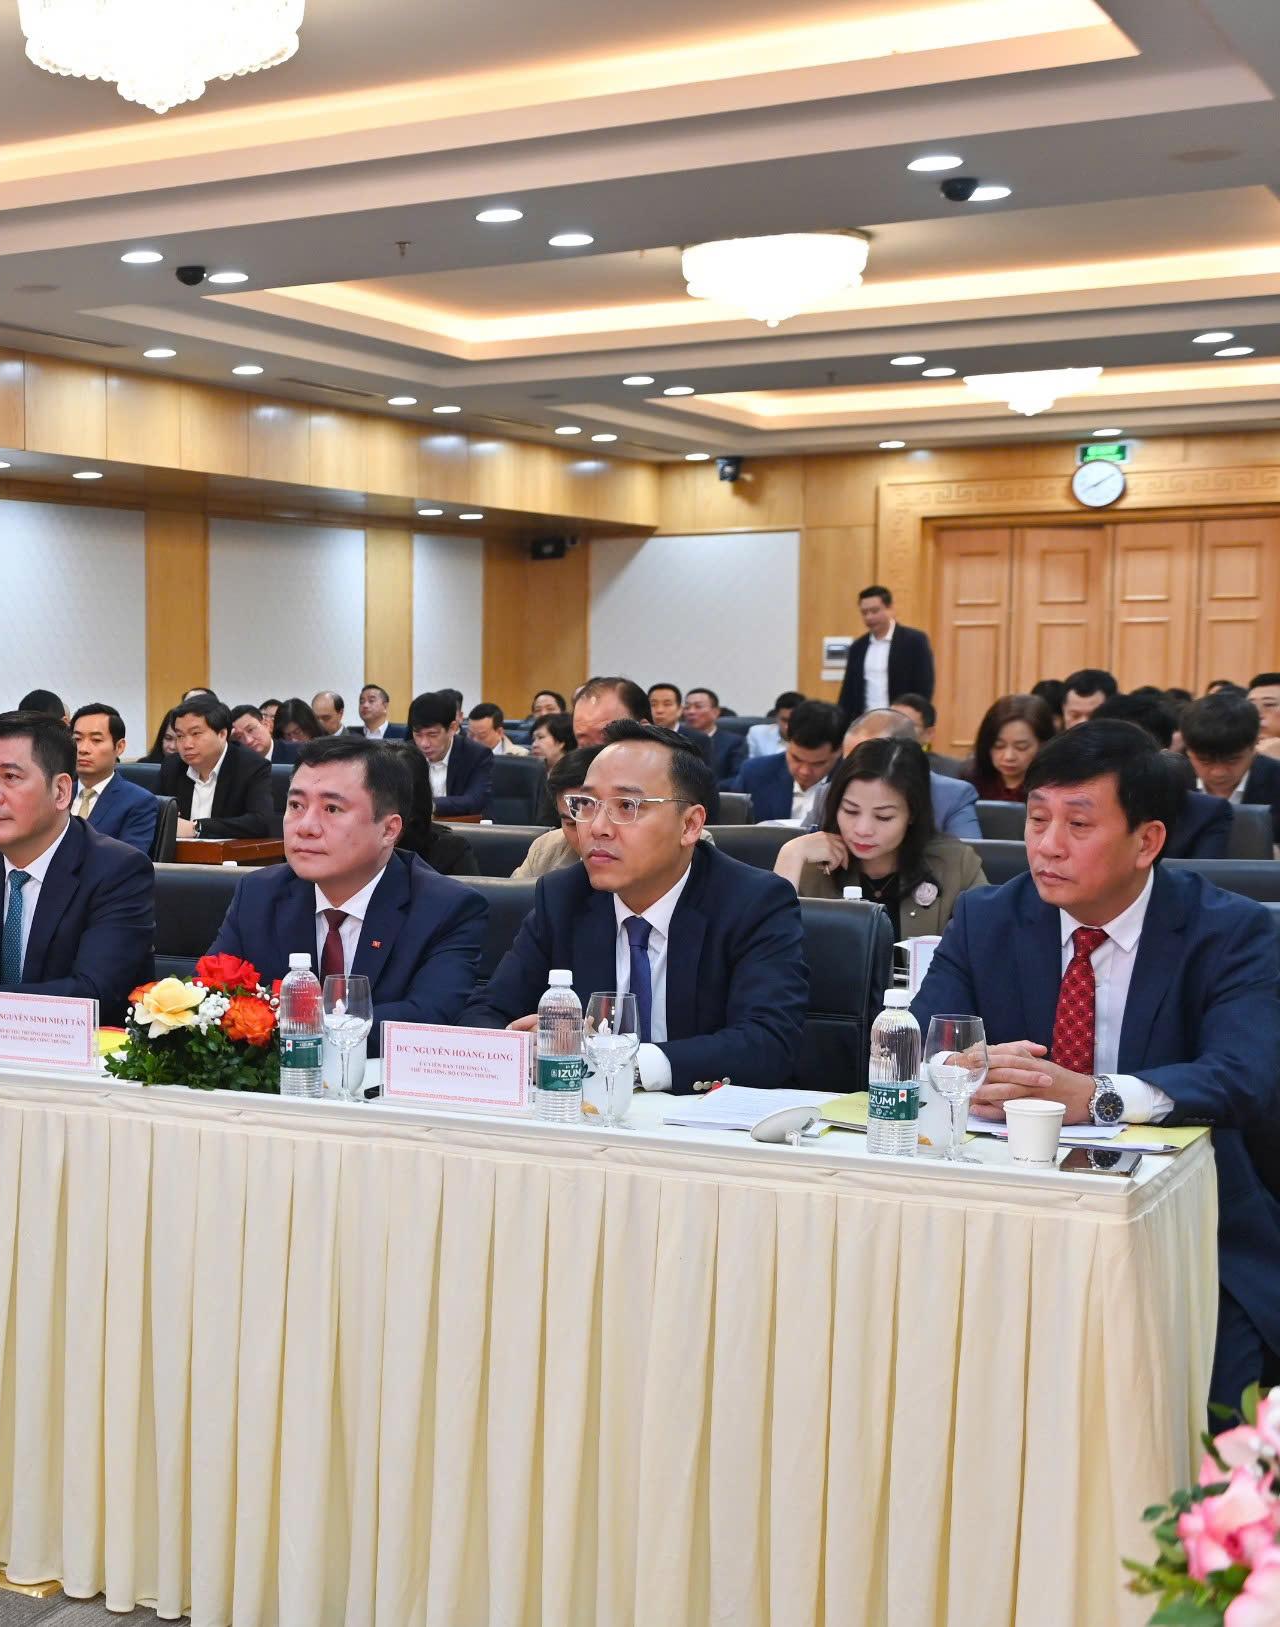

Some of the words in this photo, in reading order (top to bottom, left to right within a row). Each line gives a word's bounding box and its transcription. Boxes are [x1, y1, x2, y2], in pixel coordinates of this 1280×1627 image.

[29, 1014, 48, 1024] SINH
[486, 1051, 514, 1062] LONG
[870, 1094, 896, 1107] ZUMI
